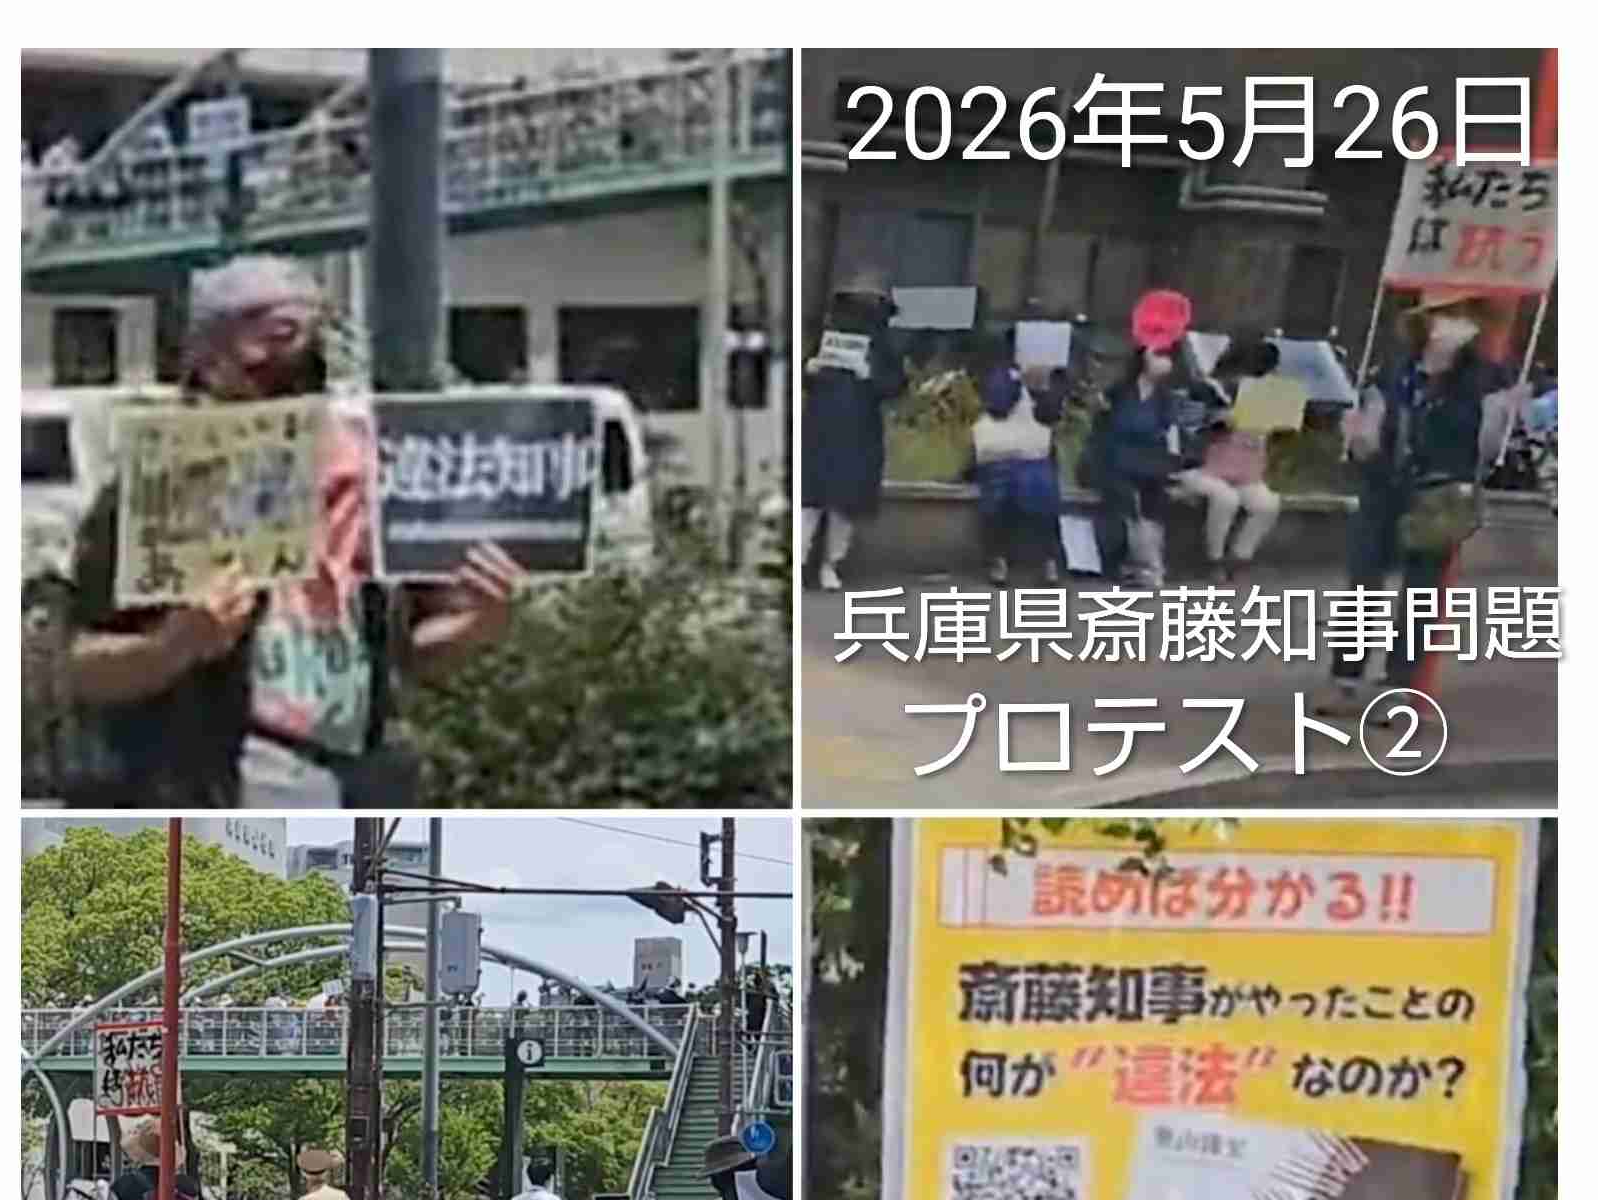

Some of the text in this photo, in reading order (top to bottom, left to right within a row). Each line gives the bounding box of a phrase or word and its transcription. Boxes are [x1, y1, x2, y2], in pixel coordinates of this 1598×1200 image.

[958, 962, 1476, 1026] 斎藤知事がやったことの
